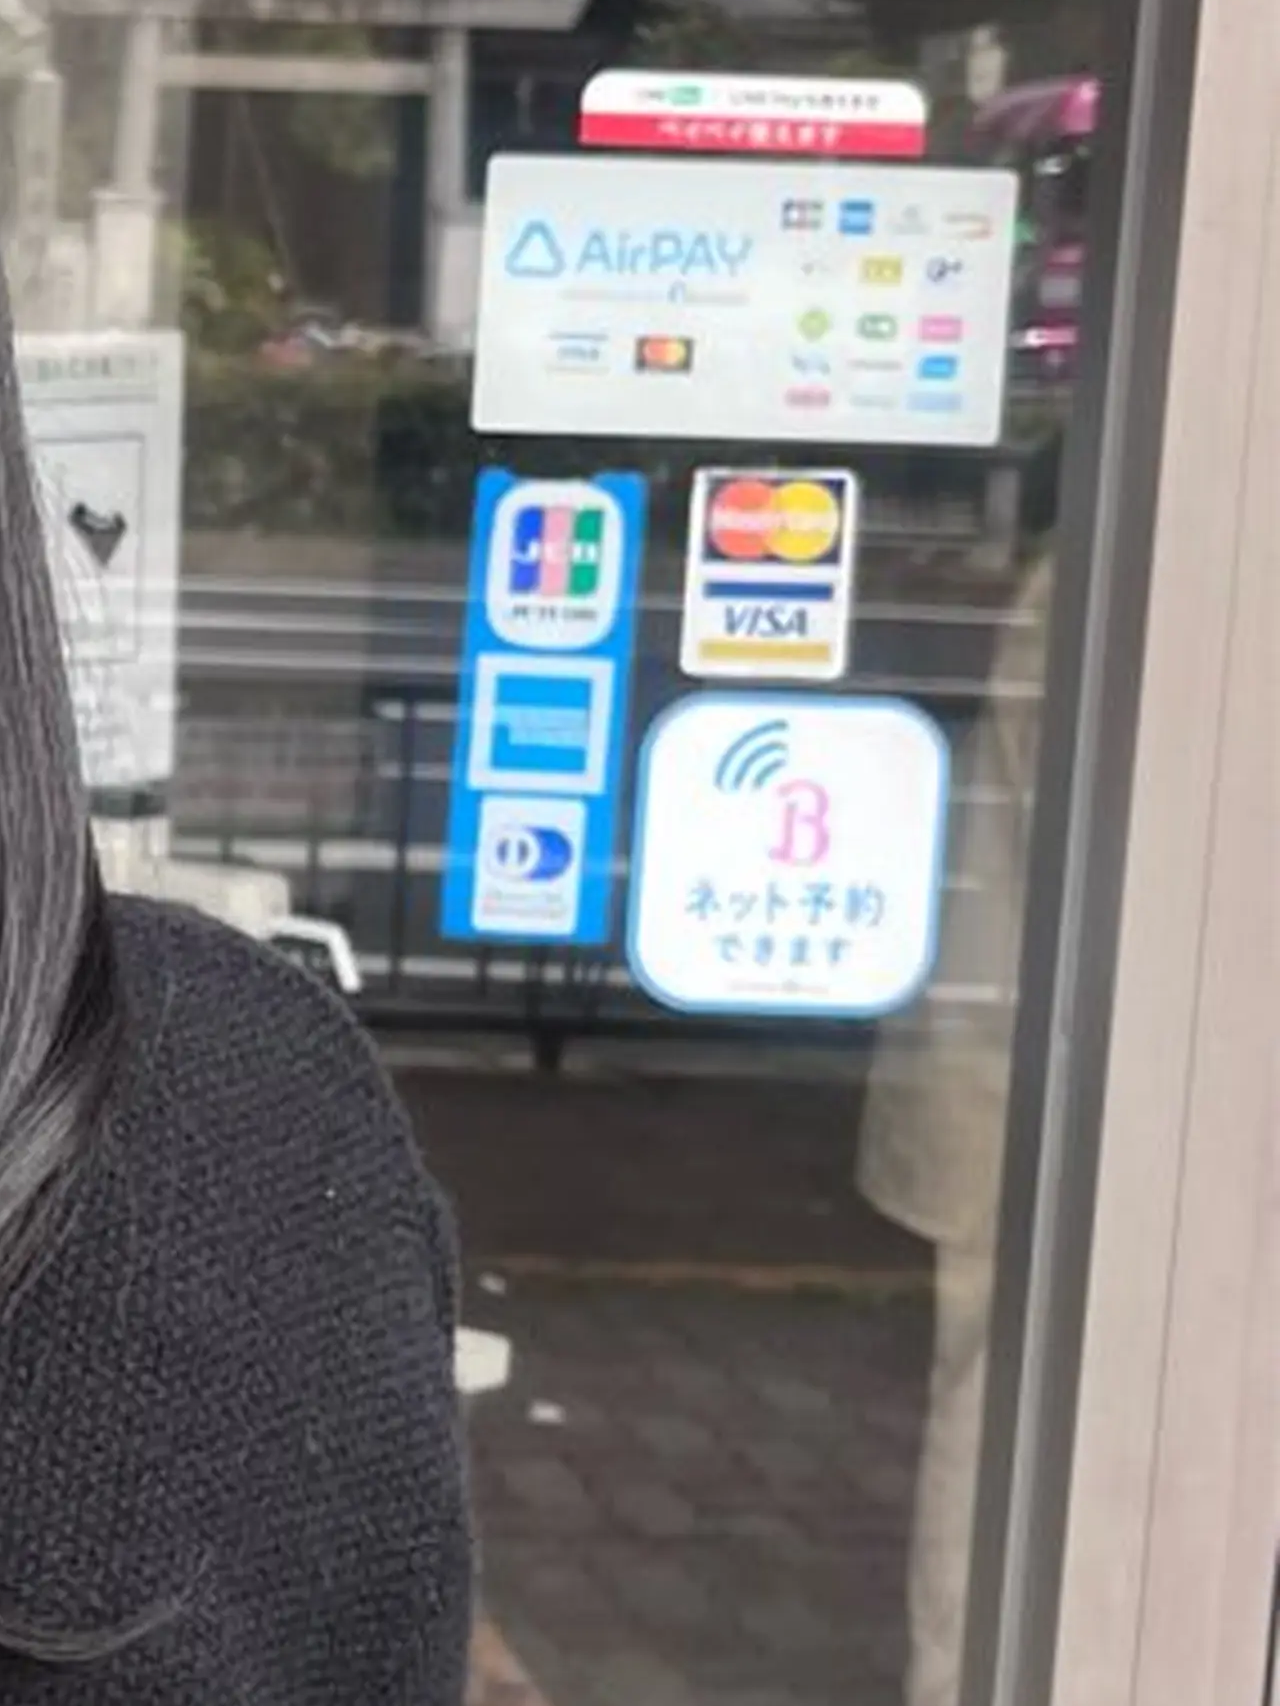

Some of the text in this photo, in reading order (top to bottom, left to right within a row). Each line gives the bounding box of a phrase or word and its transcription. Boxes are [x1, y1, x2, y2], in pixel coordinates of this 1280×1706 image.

[576, 230, 754, 276] AirPAY
[724, 605, 808, 636] VISA
[683, 878, 886, 928] ネット予約
[713, 934, 854, 967] できます
